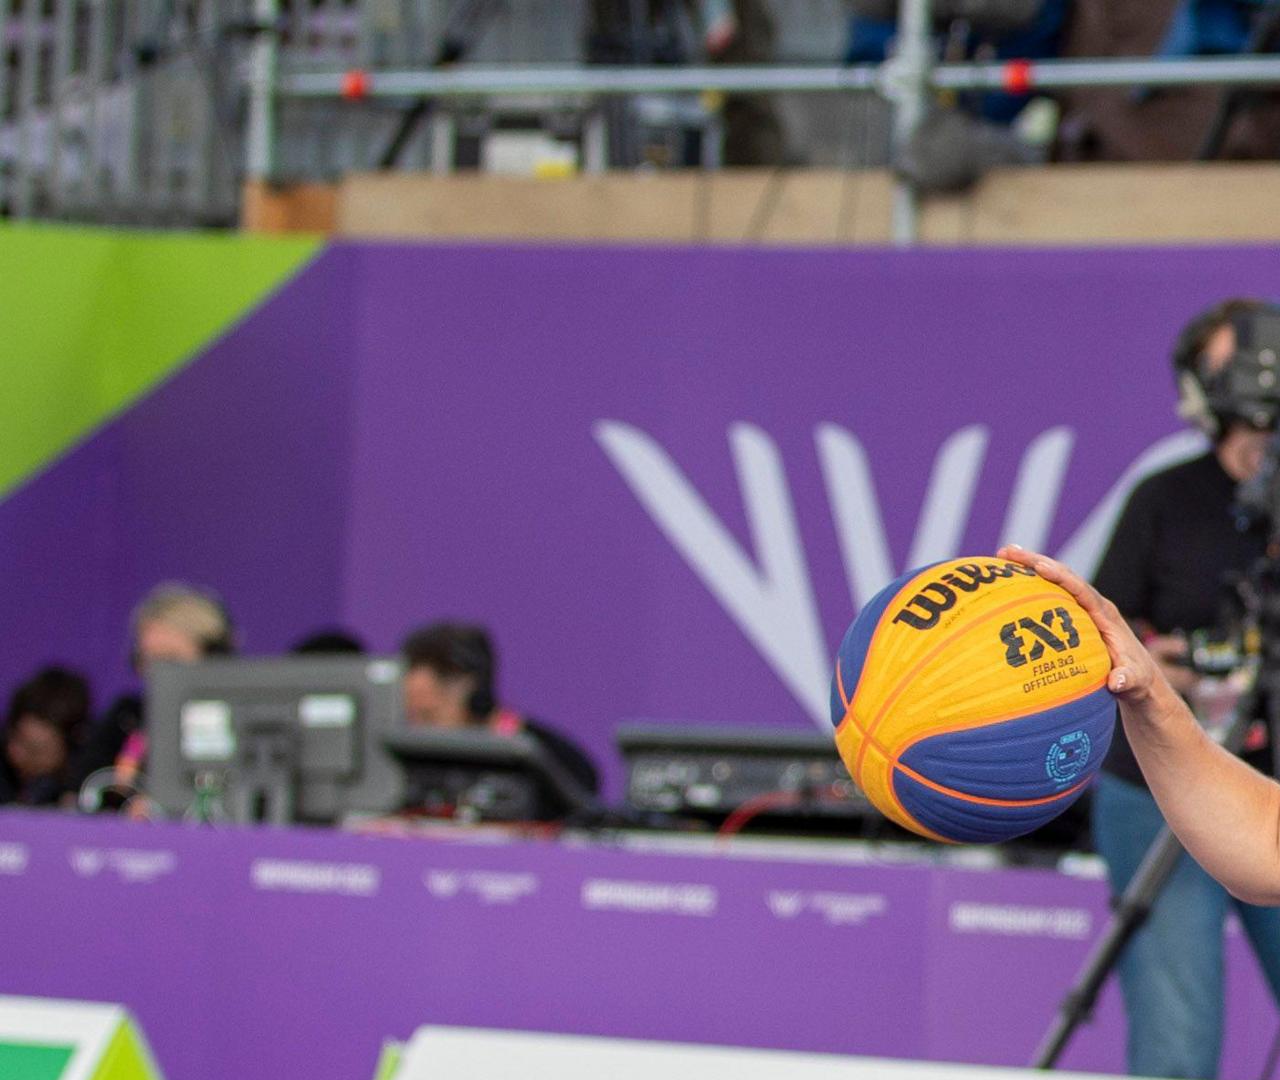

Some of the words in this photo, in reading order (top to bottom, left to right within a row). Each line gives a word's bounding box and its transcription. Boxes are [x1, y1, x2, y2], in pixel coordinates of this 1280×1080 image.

[892, 562, 1036, 630] Wilso
[1023, 671, 1069, 693] OFFICIAL
[1069, 664, 1088, 678] BALL
[1033, 660, 1056, 677] FIBA
